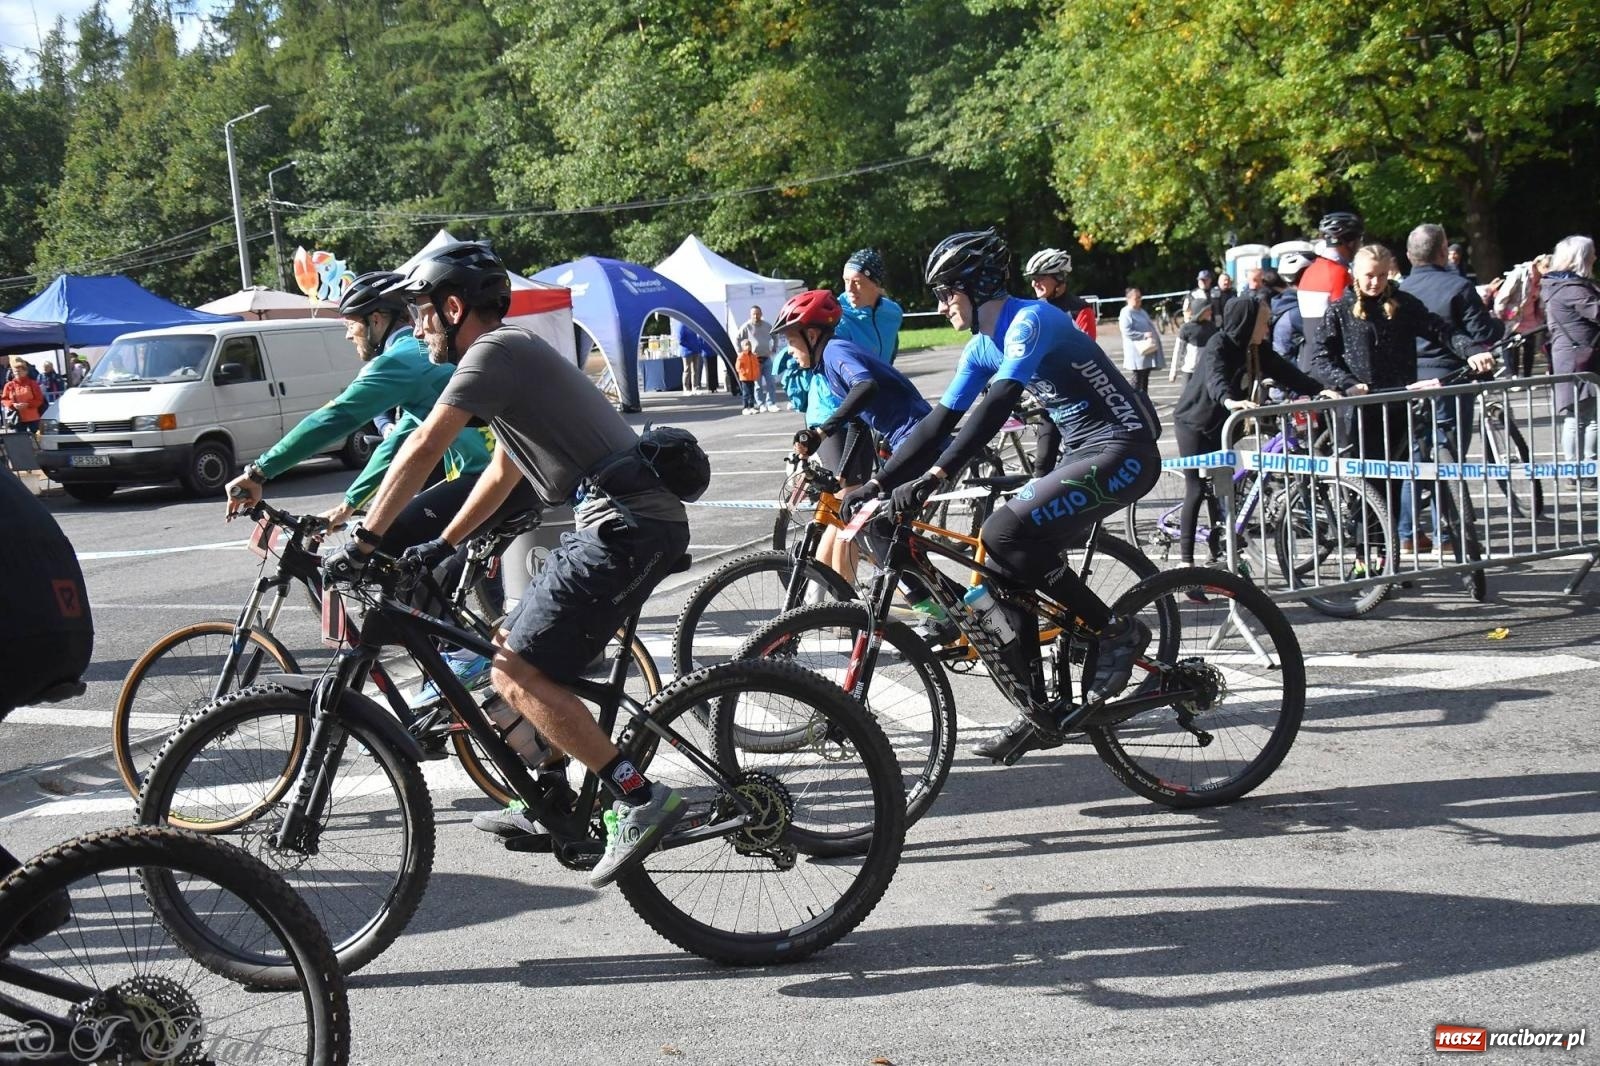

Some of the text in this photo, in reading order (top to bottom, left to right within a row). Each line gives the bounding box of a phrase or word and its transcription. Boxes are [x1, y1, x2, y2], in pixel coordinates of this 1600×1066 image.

[1072, 360, 1143, 432] JURECZKA
[1252, 455, 1329, 473] SHIMANO
[1346, 461, 1419, 477] SHIMANO
[1525, 463, 1596, 477] SHIMANO
[1031, 458, 1142, 526] FIZJO MED
[933, 680, 947, 708] JACK
[1135, 773, 1160, 791] JACK
